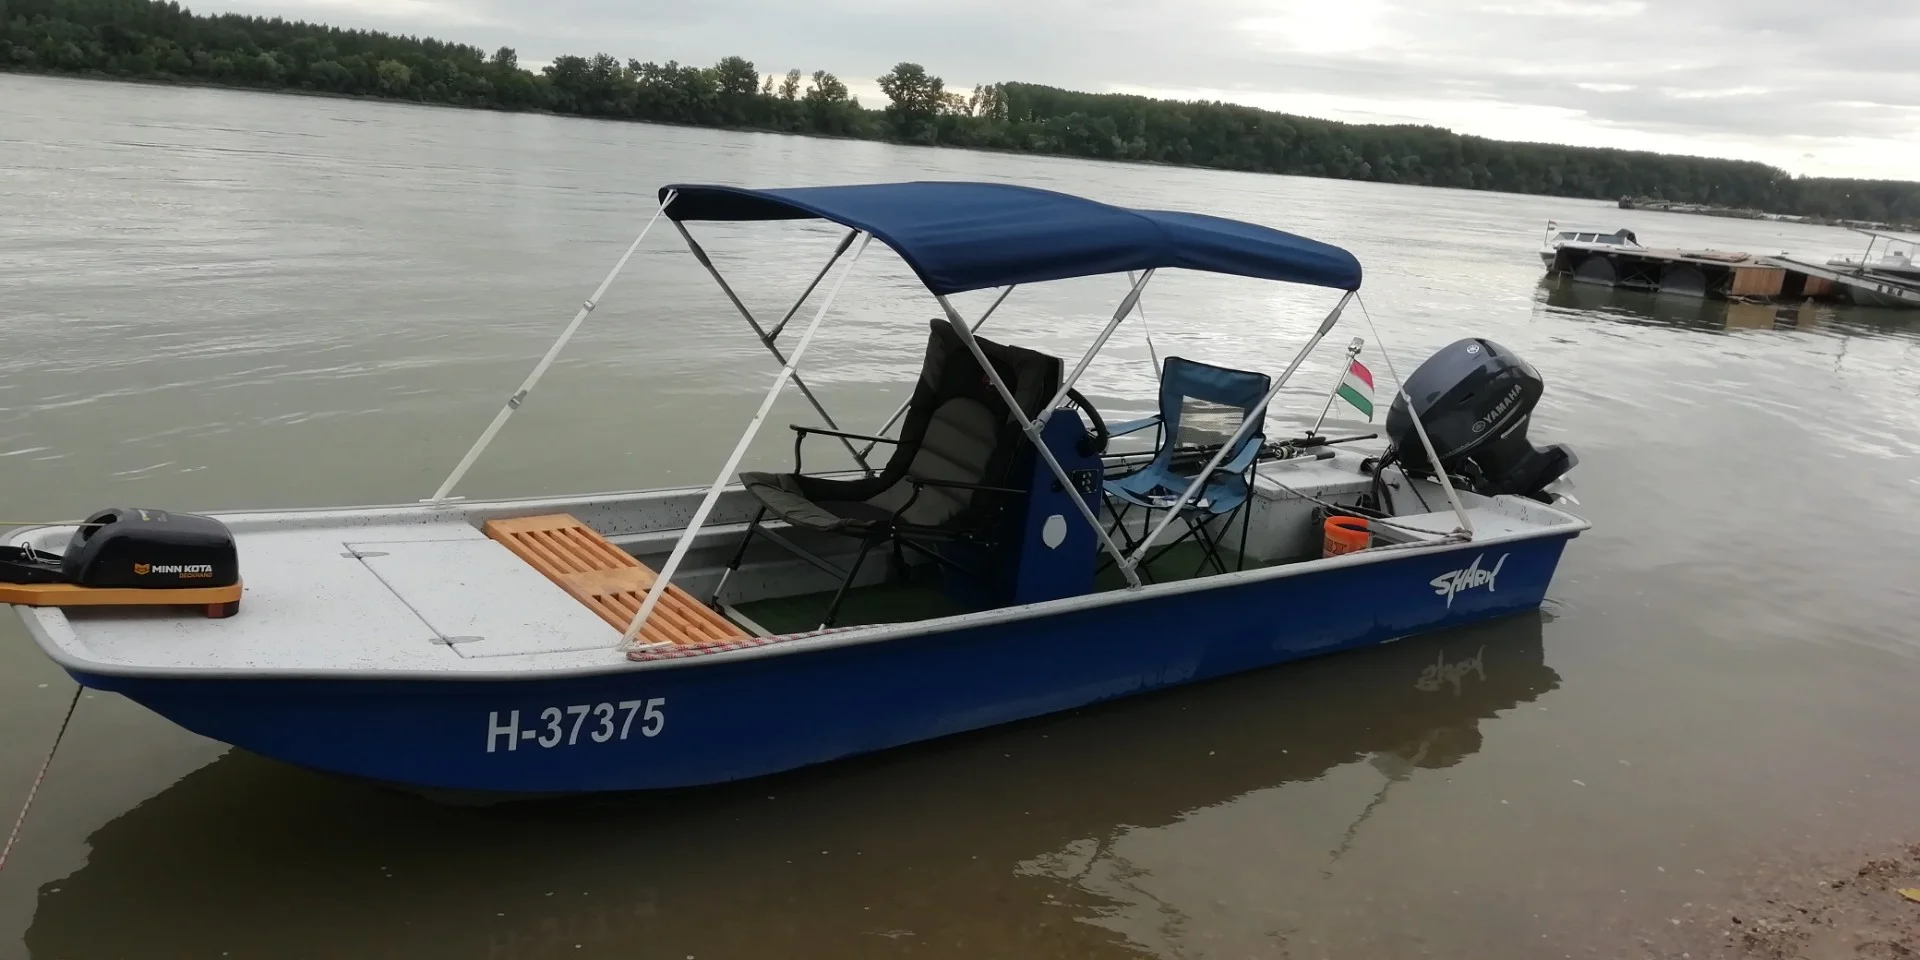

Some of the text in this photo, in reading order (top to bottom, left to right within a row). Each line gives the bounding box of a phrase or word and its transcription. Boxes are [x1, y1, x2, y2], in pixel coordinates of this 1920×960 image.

[1483, 384, 1522, 423] YAMAHA
[152, 564, 213, 573] MINN KOTA
[1429, 552, 1511, 609] SHARK
[486, 697, 666, 753] H-37375
